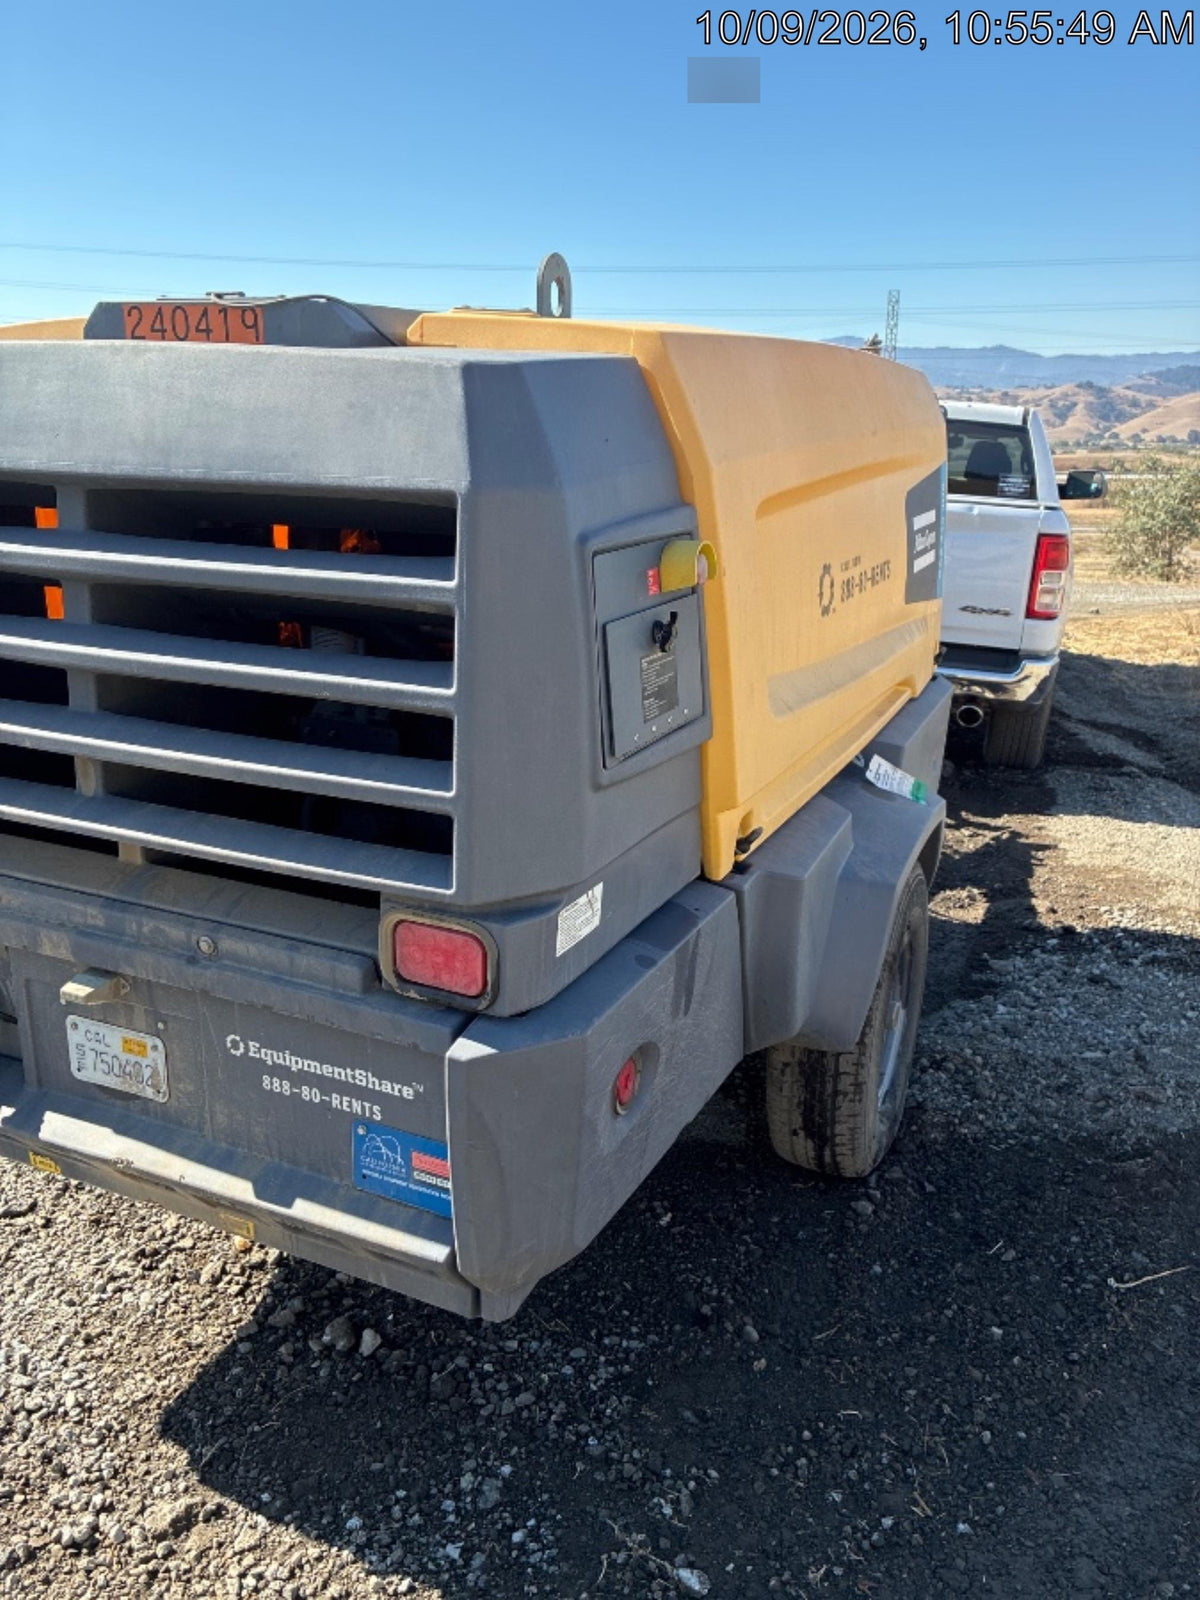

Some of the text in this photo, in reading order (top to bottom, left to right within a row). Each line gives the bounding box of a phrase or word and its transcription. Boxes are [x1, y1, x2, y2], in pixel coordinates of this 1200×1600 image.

[127, 304, 261, 342] 240419
[84, 1029, 111, 1048] CAL
[248, 1040, 415, 1100] EquipmentShare
[262, 1074, 383, 1121] 888-80-RENTS
